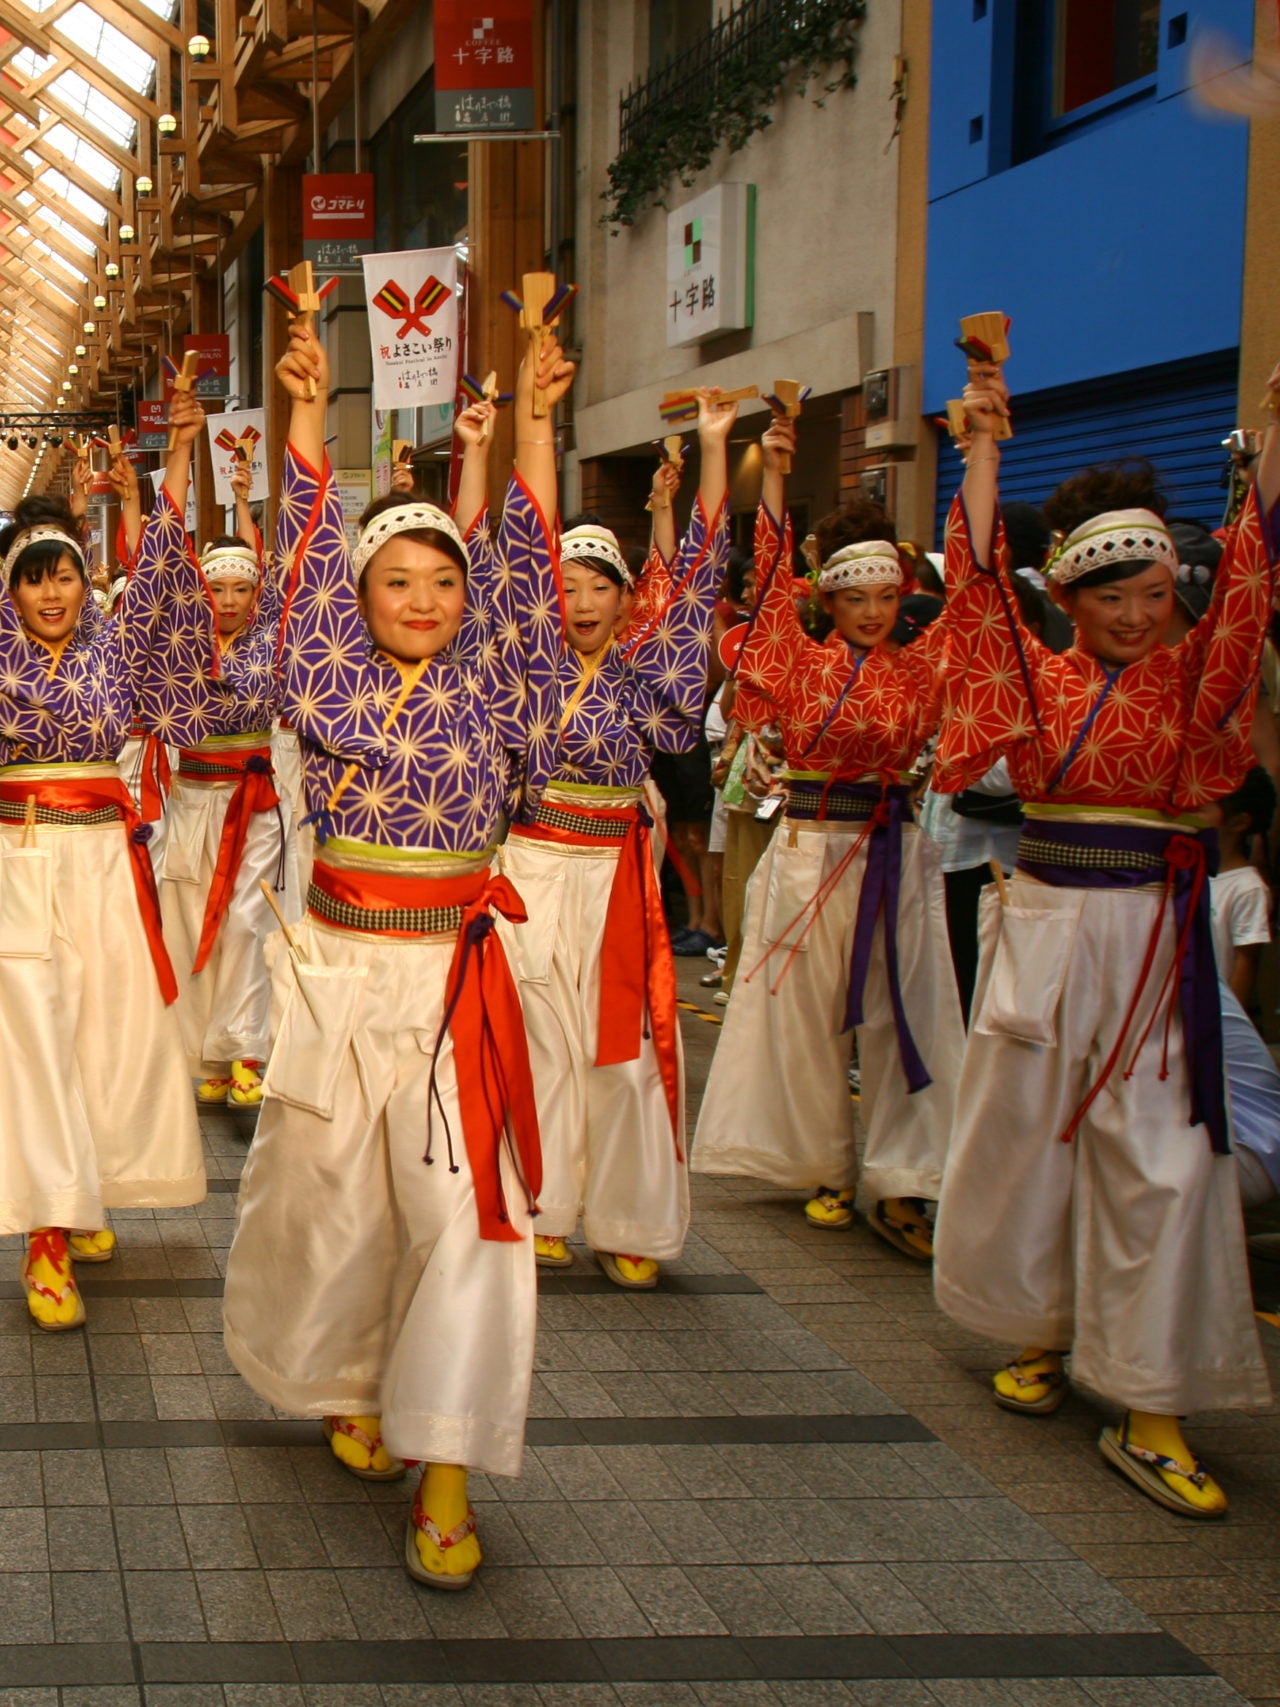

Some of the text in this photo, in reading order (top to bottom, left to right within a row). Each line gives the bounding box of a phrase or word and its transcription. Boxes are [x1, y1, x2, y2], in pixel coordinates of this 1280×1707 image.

[451, 46, 515, 66] 十字路
[327, 199, 366, 211] コマドリ
[669, 273, 716, 323] 十字路
[393, 336, 453, 358] よさこい祭り
